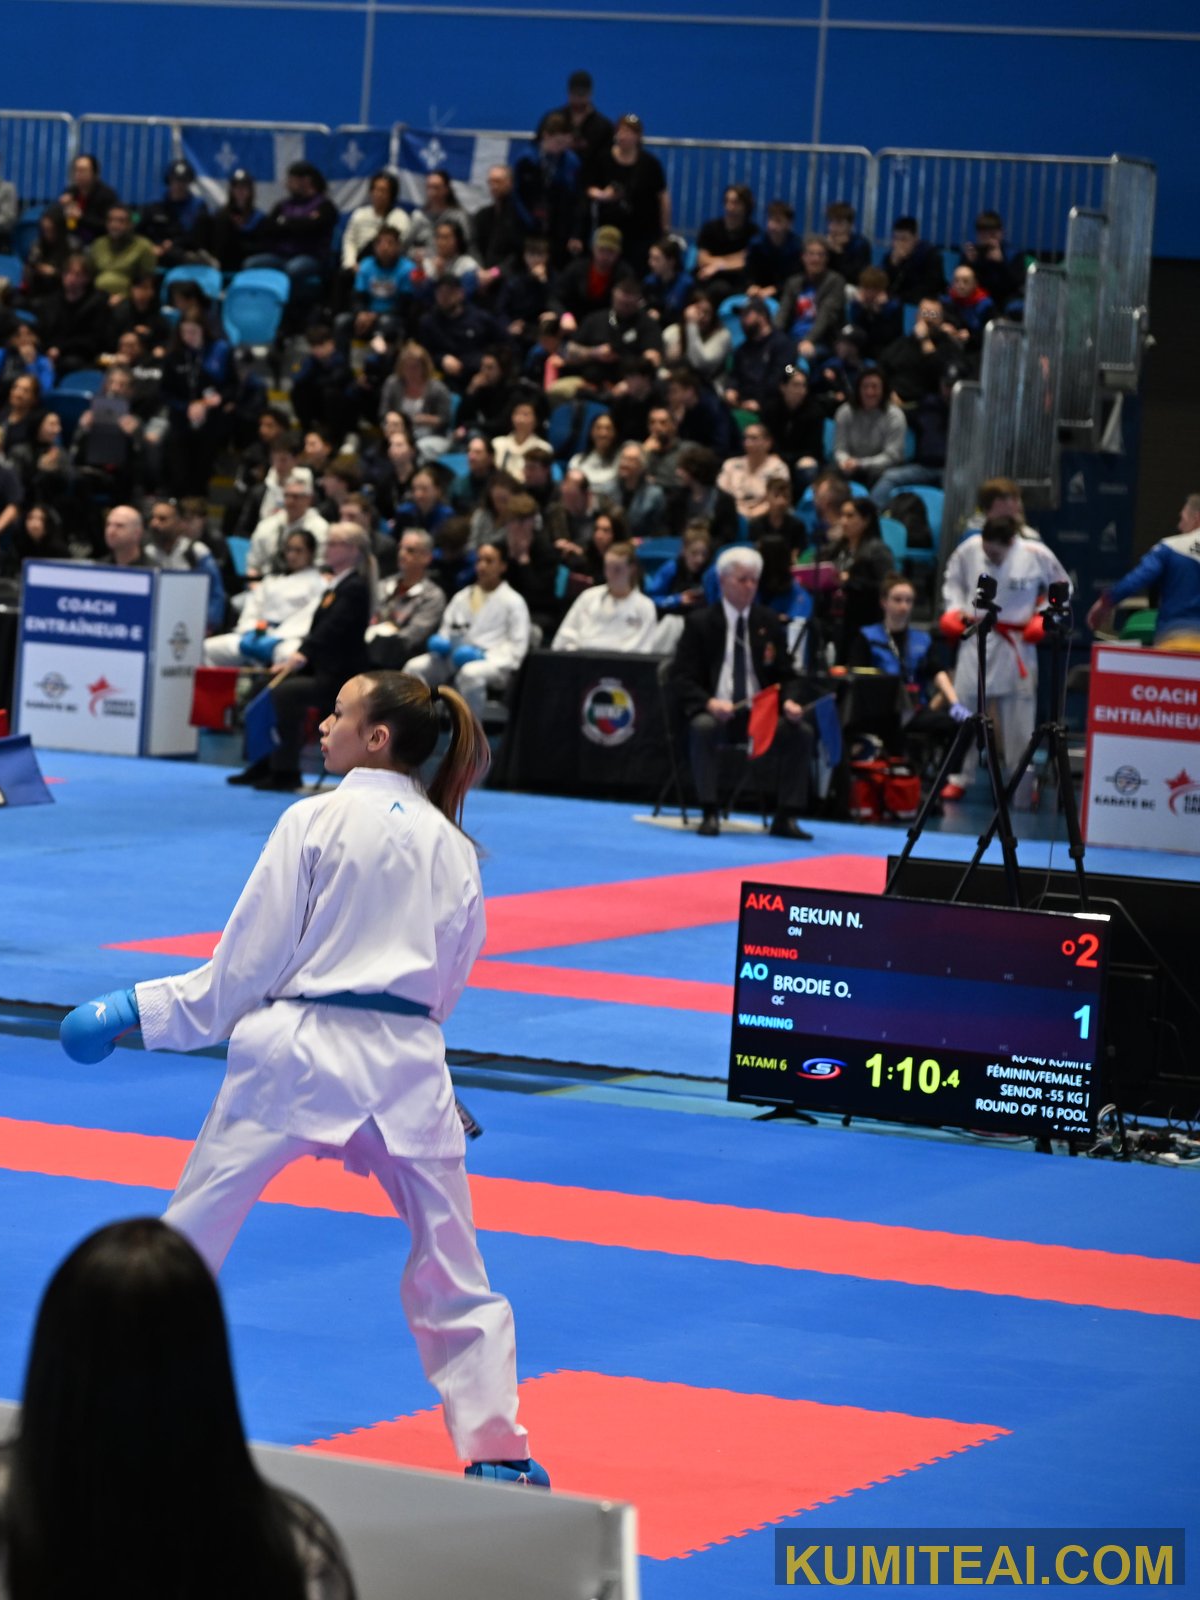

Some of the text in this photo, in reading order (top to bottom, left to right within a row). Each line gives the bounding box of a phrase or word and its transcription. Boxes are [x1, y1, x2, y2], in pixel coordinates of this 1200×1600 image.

[57, 596, 117, 616] COACH
[1131, 684, 1198, 706] COACH
[1094, 704, 1200, 731] ENTRAÎNEU
[745, 893, 785, 912] AKA
[789, 906, 864, 929] REKUN N.
[787, 926, 802, 937] ON
[744, 944, 799, 960] WARNING
[739, 962, 769, 981] AO
[773, 974, 852, 999] BRODIE O.
[771, 994, 785, 1006] QC
[738, 1013, 794, 1031] WARNING
[1073, 1004, 1091, 1040] 1
[735, 1054, 788, 1071] TATAMI 6
[865, 1053, 961, 1094] 1:10.4
[986, 1063, 1083, 1088] FÉMININ/FEMALE
[1000, 1083, 1043, 1100] SENIOR
[1045, 1089, 1064, 1103] -55
[1066, 1091, 1083, 1105] KG
[975, 1098, 1089, 1123] ROUND OF 16 POOL
